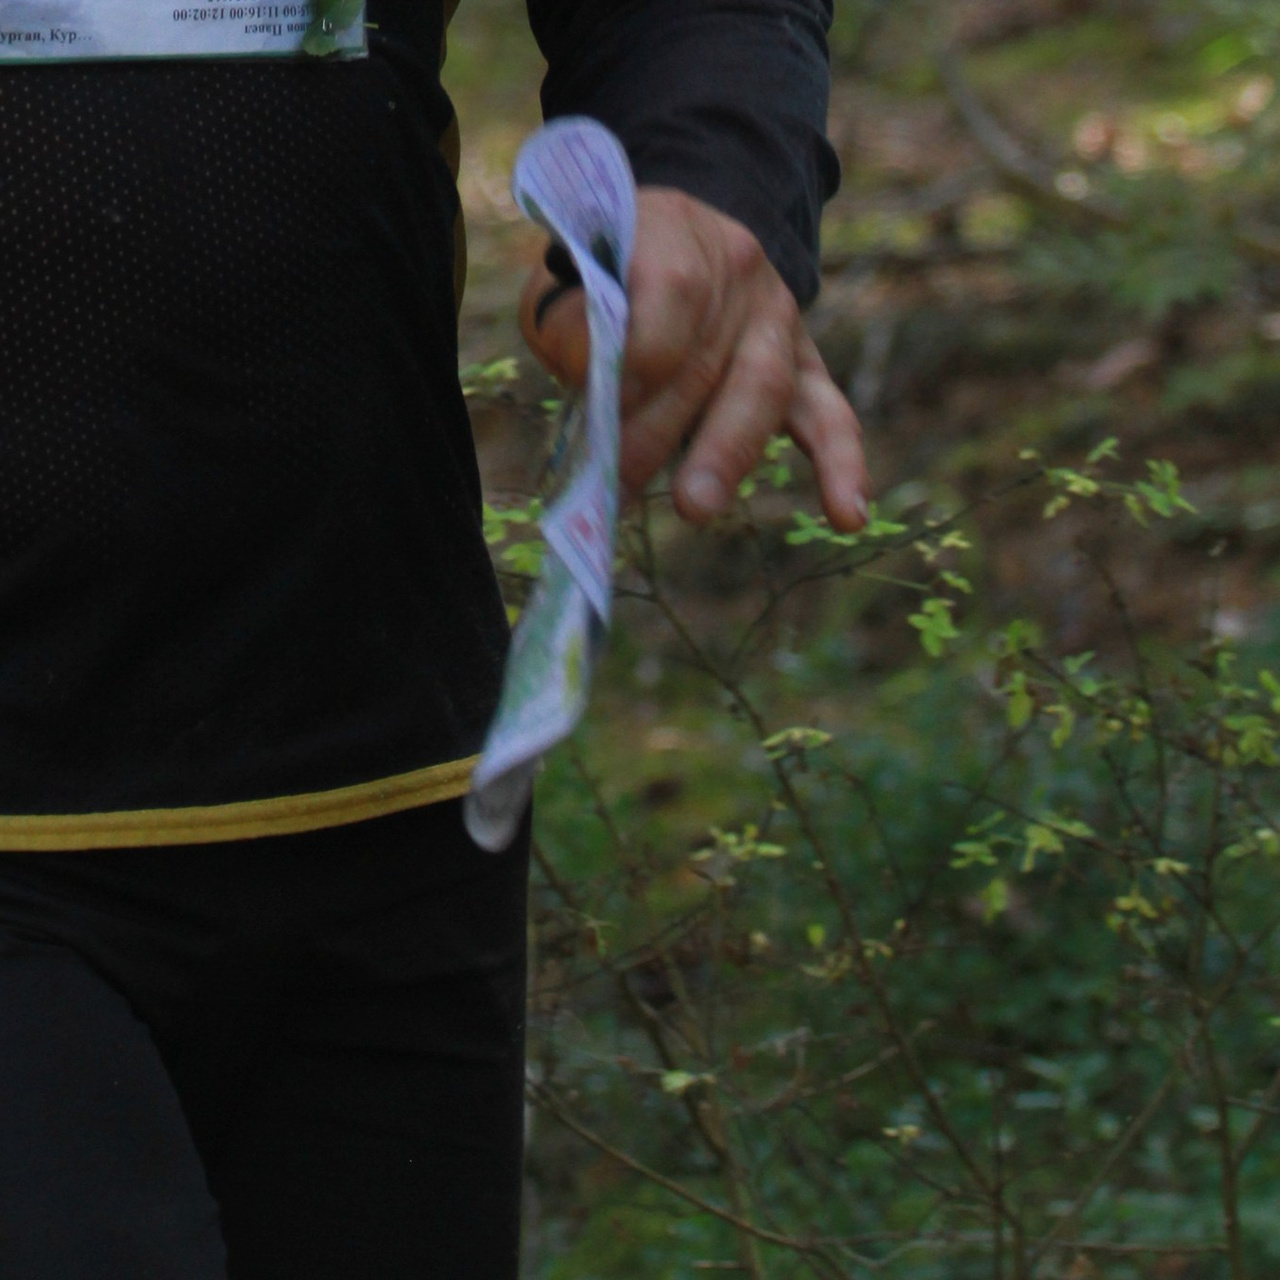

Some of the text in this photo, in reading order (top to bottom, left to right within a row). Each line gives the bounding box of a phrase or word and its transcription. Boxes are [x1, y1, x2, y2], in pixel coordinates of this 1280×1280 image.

[173, 8, 225, 22] 12:02:00
[230, 6, 279, 19] 11:16:00
[244, 24, 282, 36] Павел
